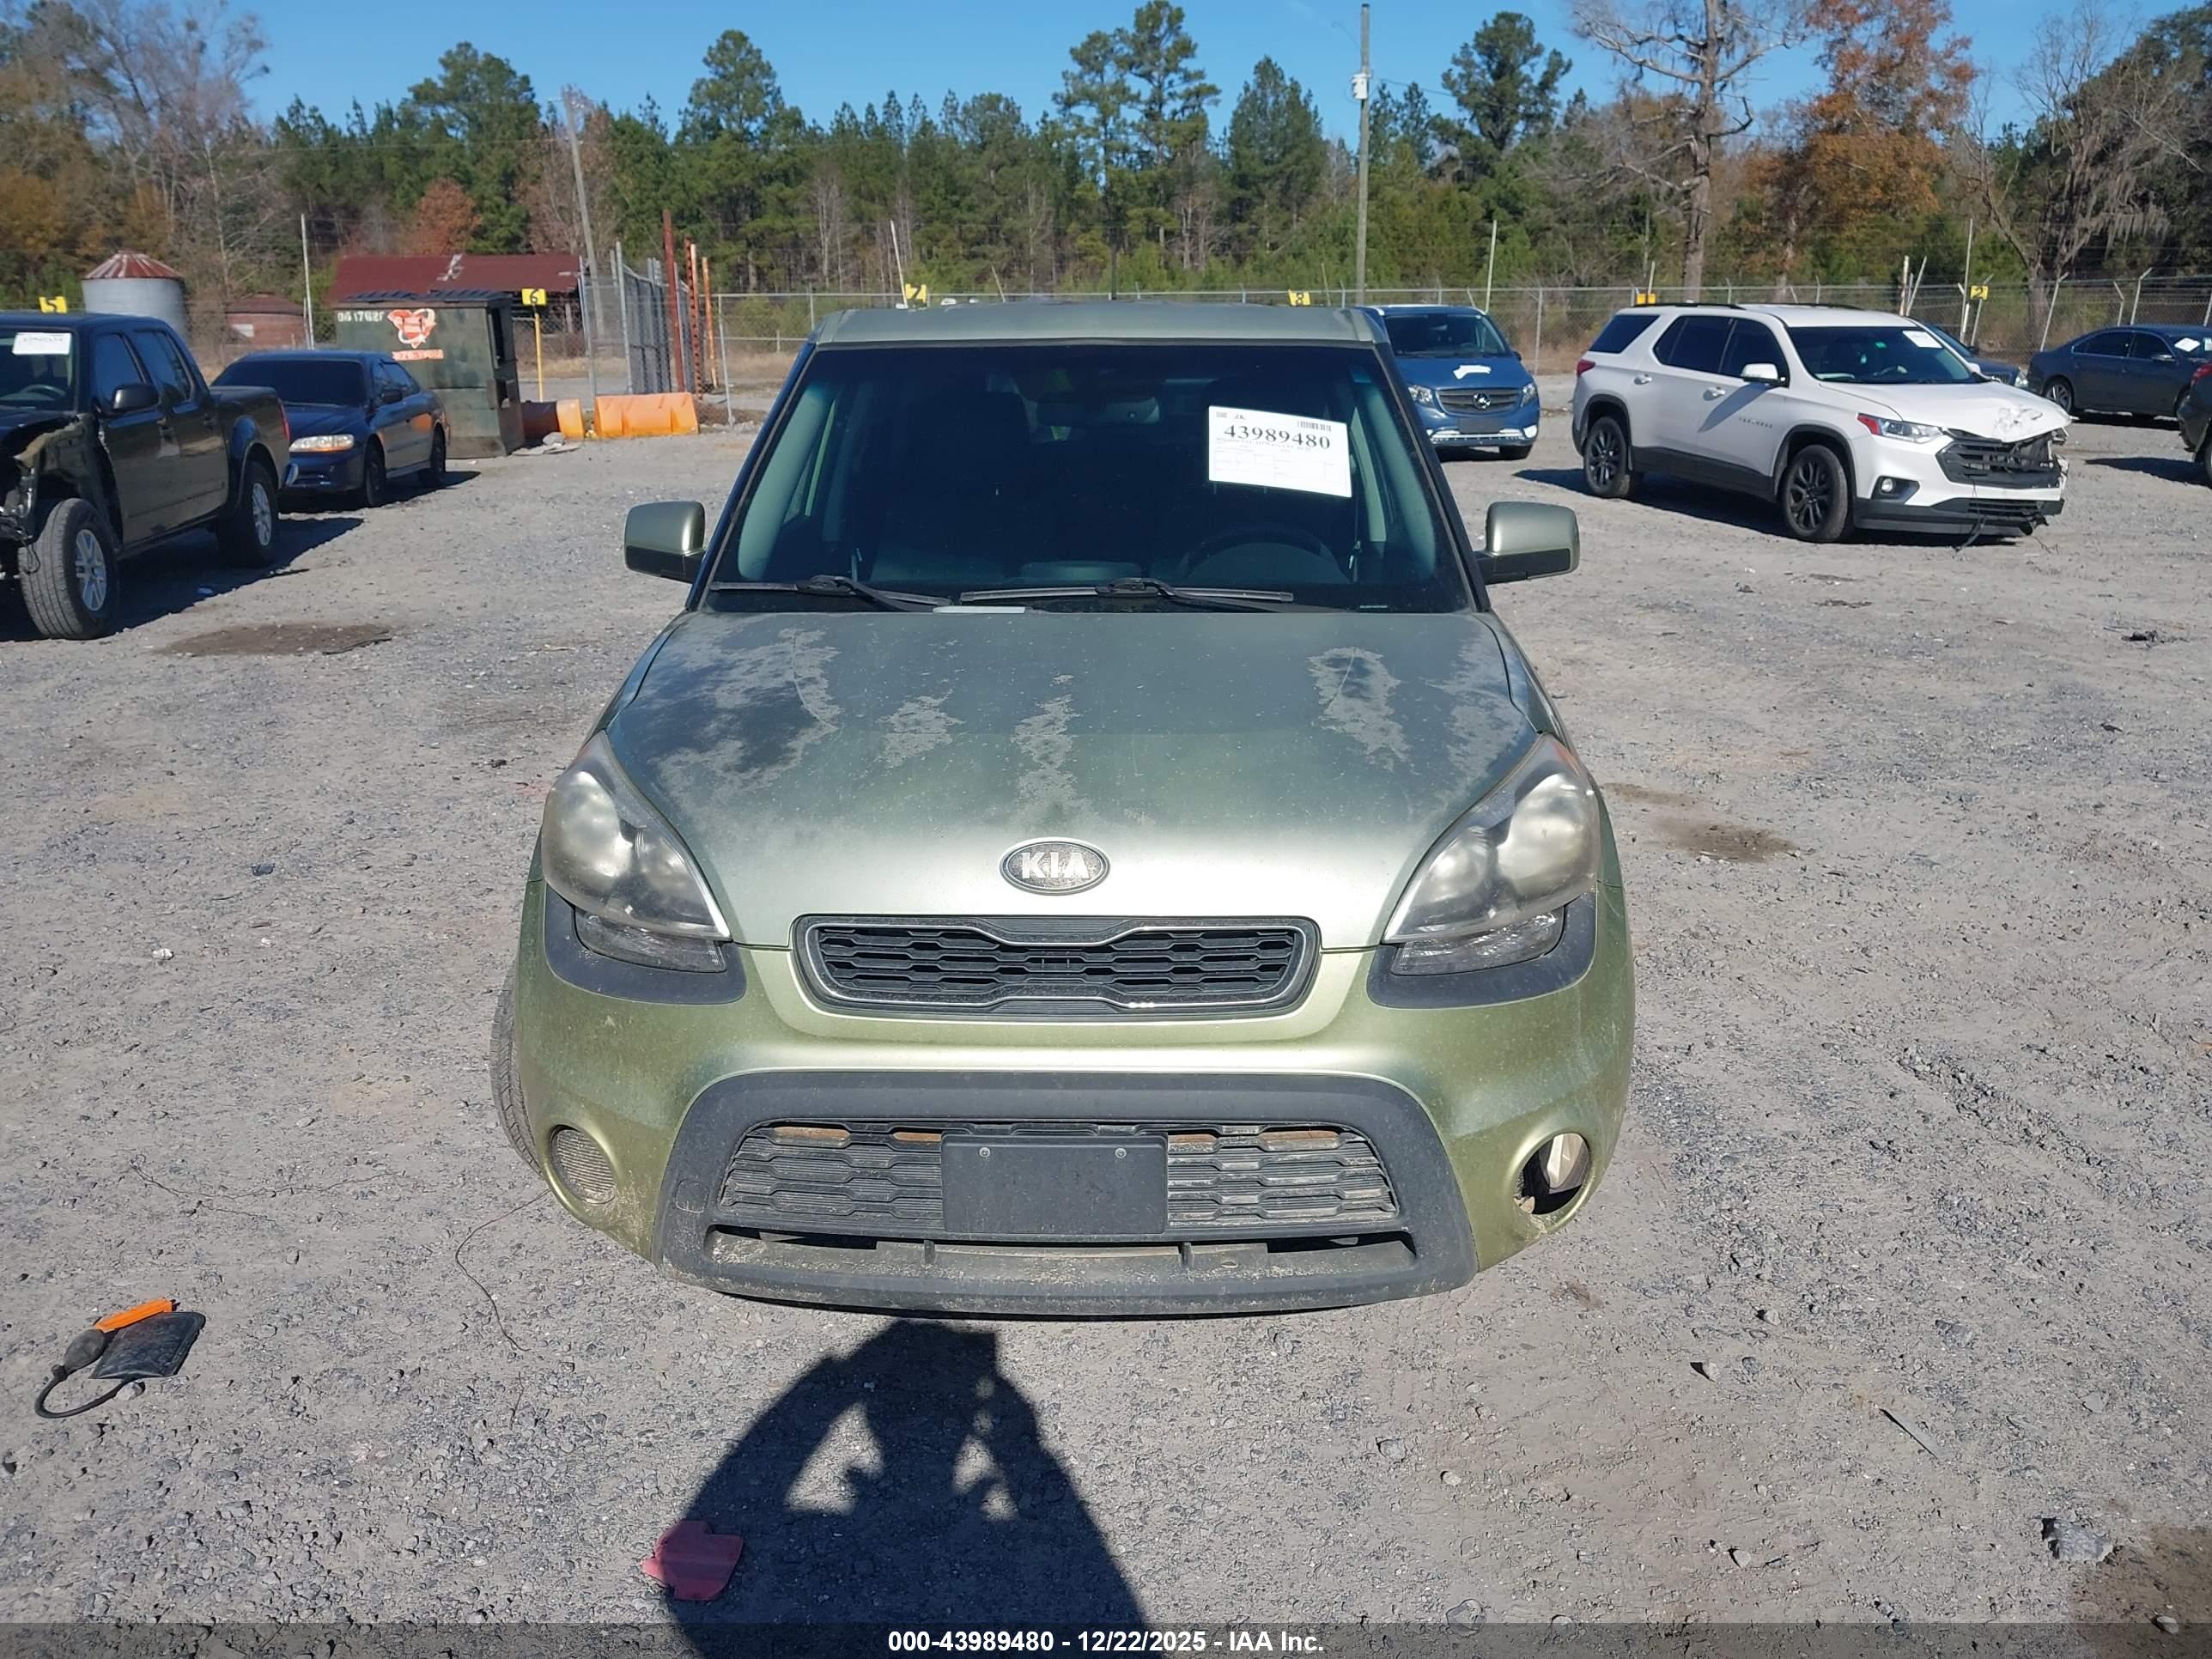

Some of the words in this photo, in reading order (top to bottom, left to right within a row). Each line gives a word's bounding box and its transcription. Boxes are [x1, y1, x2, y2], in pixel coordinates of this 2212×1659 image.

[530, 289, 539, 304] 6
[910, 284, 921, 300] 7
[1295, 291, 1304, 307] 8
[1972, 285, 1984, 300] 2
[45, 296, 58, 313] 5
[1224, 423, 1331, 450] 43989480
[1021, 852, 1091, 879] KIA
